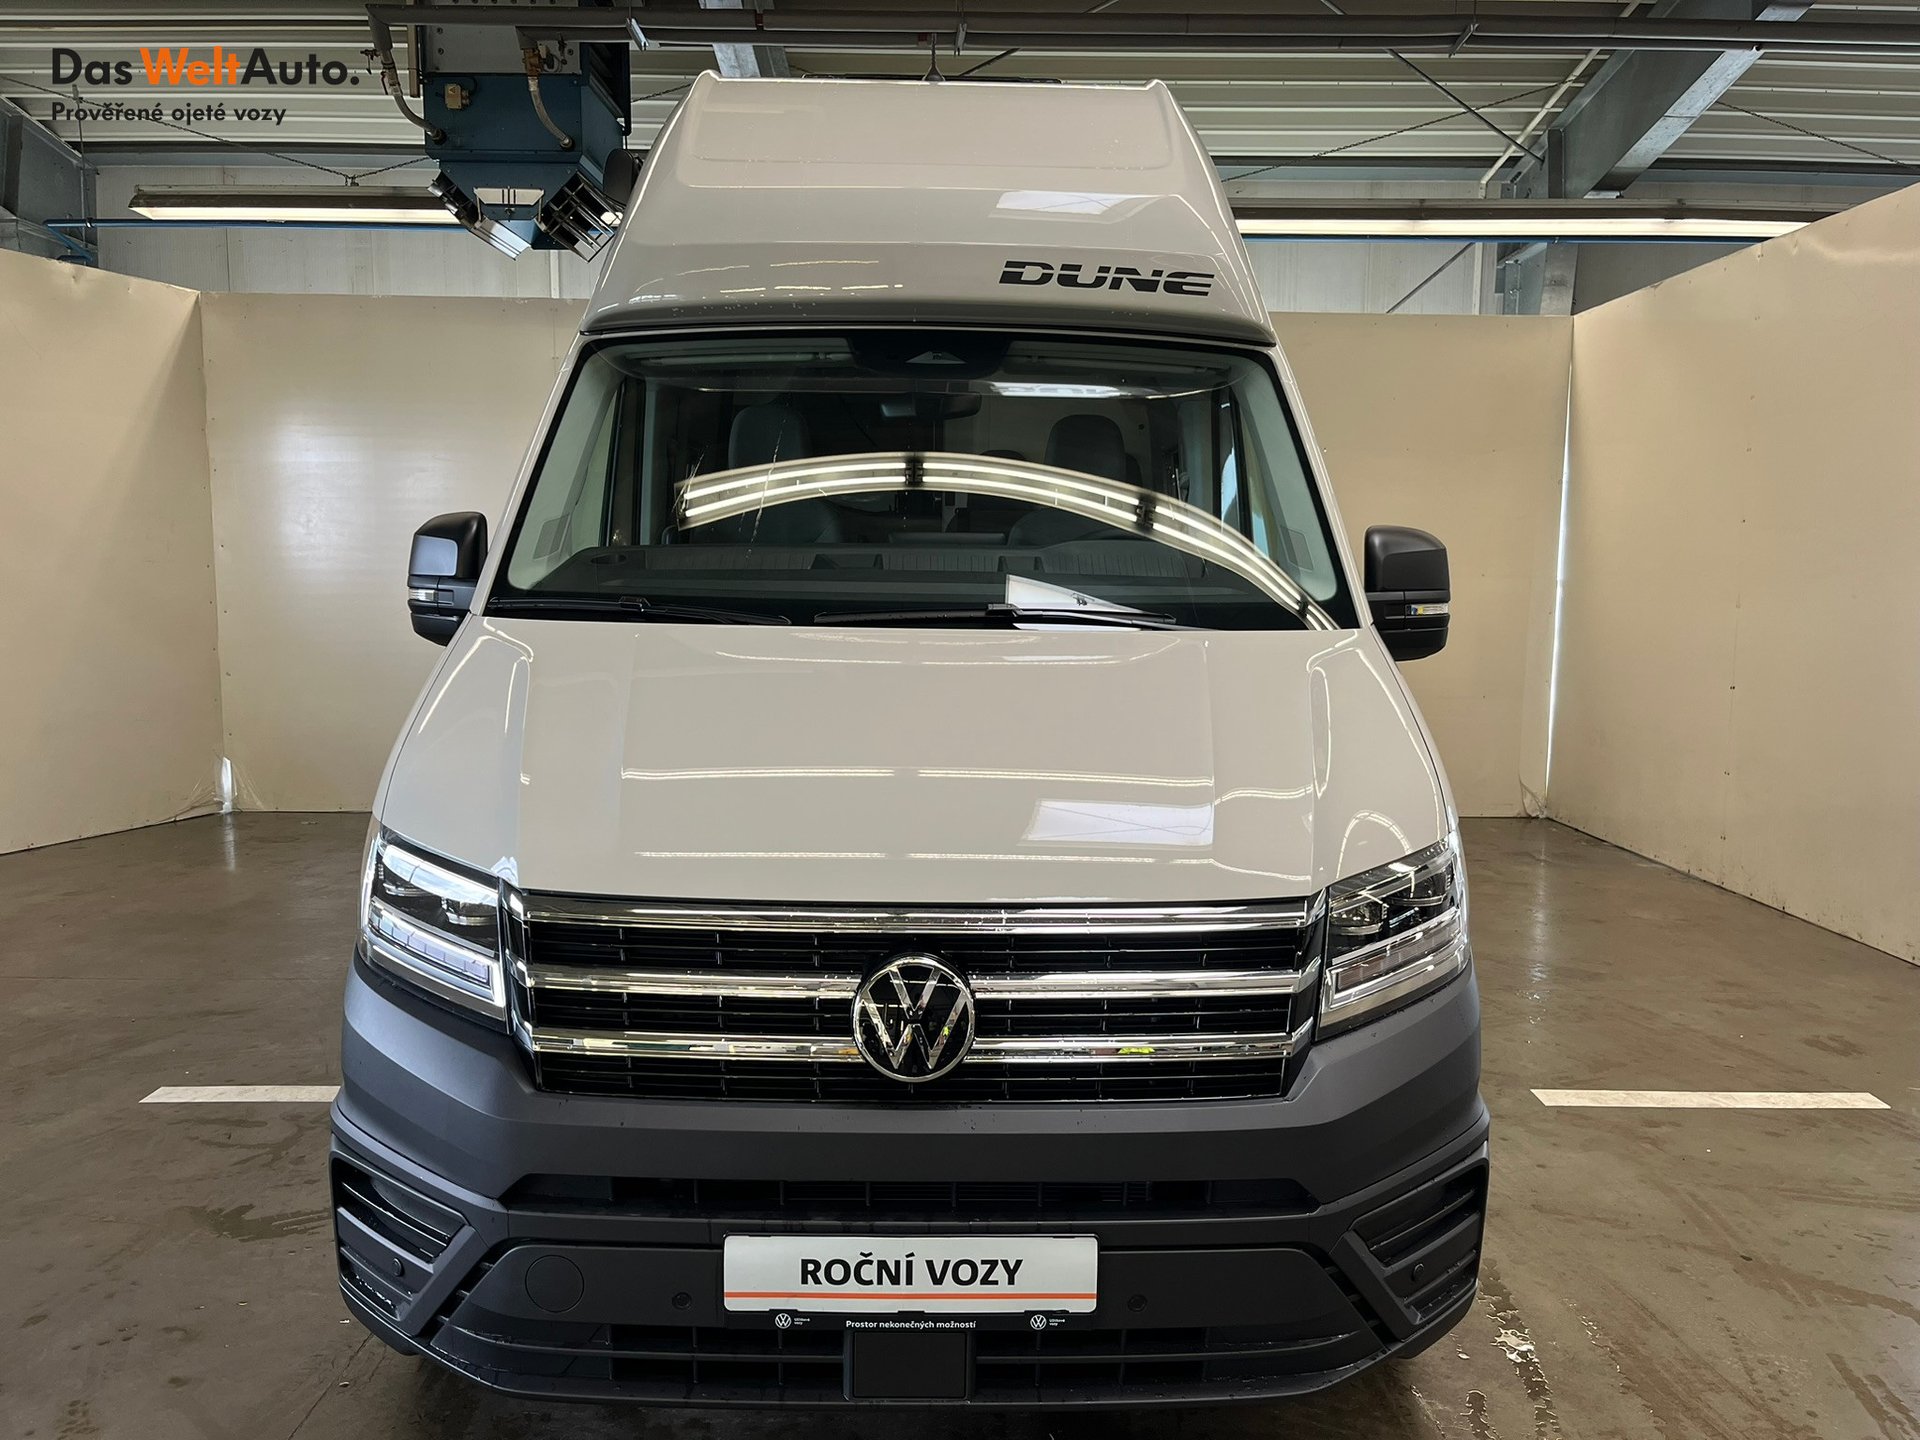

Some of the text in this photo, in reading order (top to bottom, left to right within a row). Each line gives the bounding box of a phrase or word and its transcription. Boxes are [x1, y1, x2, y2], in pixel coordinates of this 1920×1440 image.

[999, 260, 1215, 297] DUNE
[800, 1251, 1024, 1286] ROČNÍ VOZY
[845, 1320, 977, 1330] Prostor nekonečných možností
